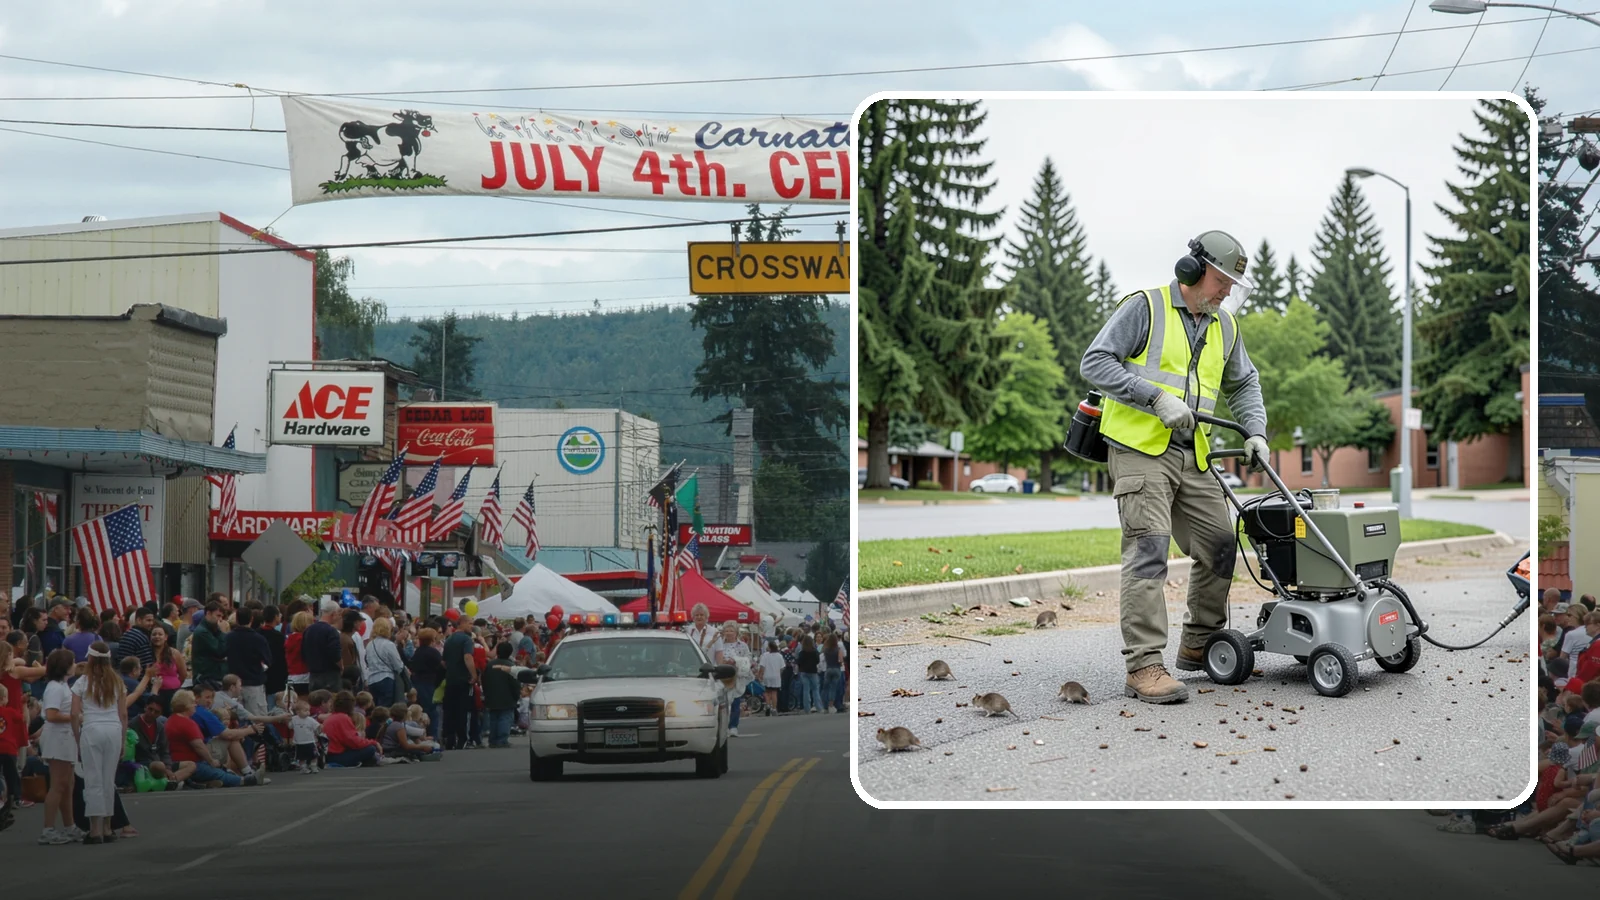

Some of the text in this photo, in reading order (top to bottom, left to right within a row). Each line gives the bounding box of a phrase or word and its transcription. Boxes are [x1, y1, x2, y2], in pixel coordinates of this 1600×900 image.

[695, 121, 850, 149] Carnat
[481, 141, 605, 192] JULY
[632, 150, 746, 197] 4th.
[697, 254, 850, 279] CROSSWA
[283, 380, 373, 420] ACE
[406, 409, 485, 421] CEDAR LOG
[283, 421, 371, 436] Hardware
[416, 428, 477, 447] Coca-Cola
[95, 485, 124, 494] Vincent
[126, 486, 136, 494] de
[137, 486, 155, 495] Paul
[81, 503, 153, 521] THT
[212, 516, 330, 535] HARDARE
[688, 527, 741, 535] CRNATION
[699, 535, 730, 543] GLASS
